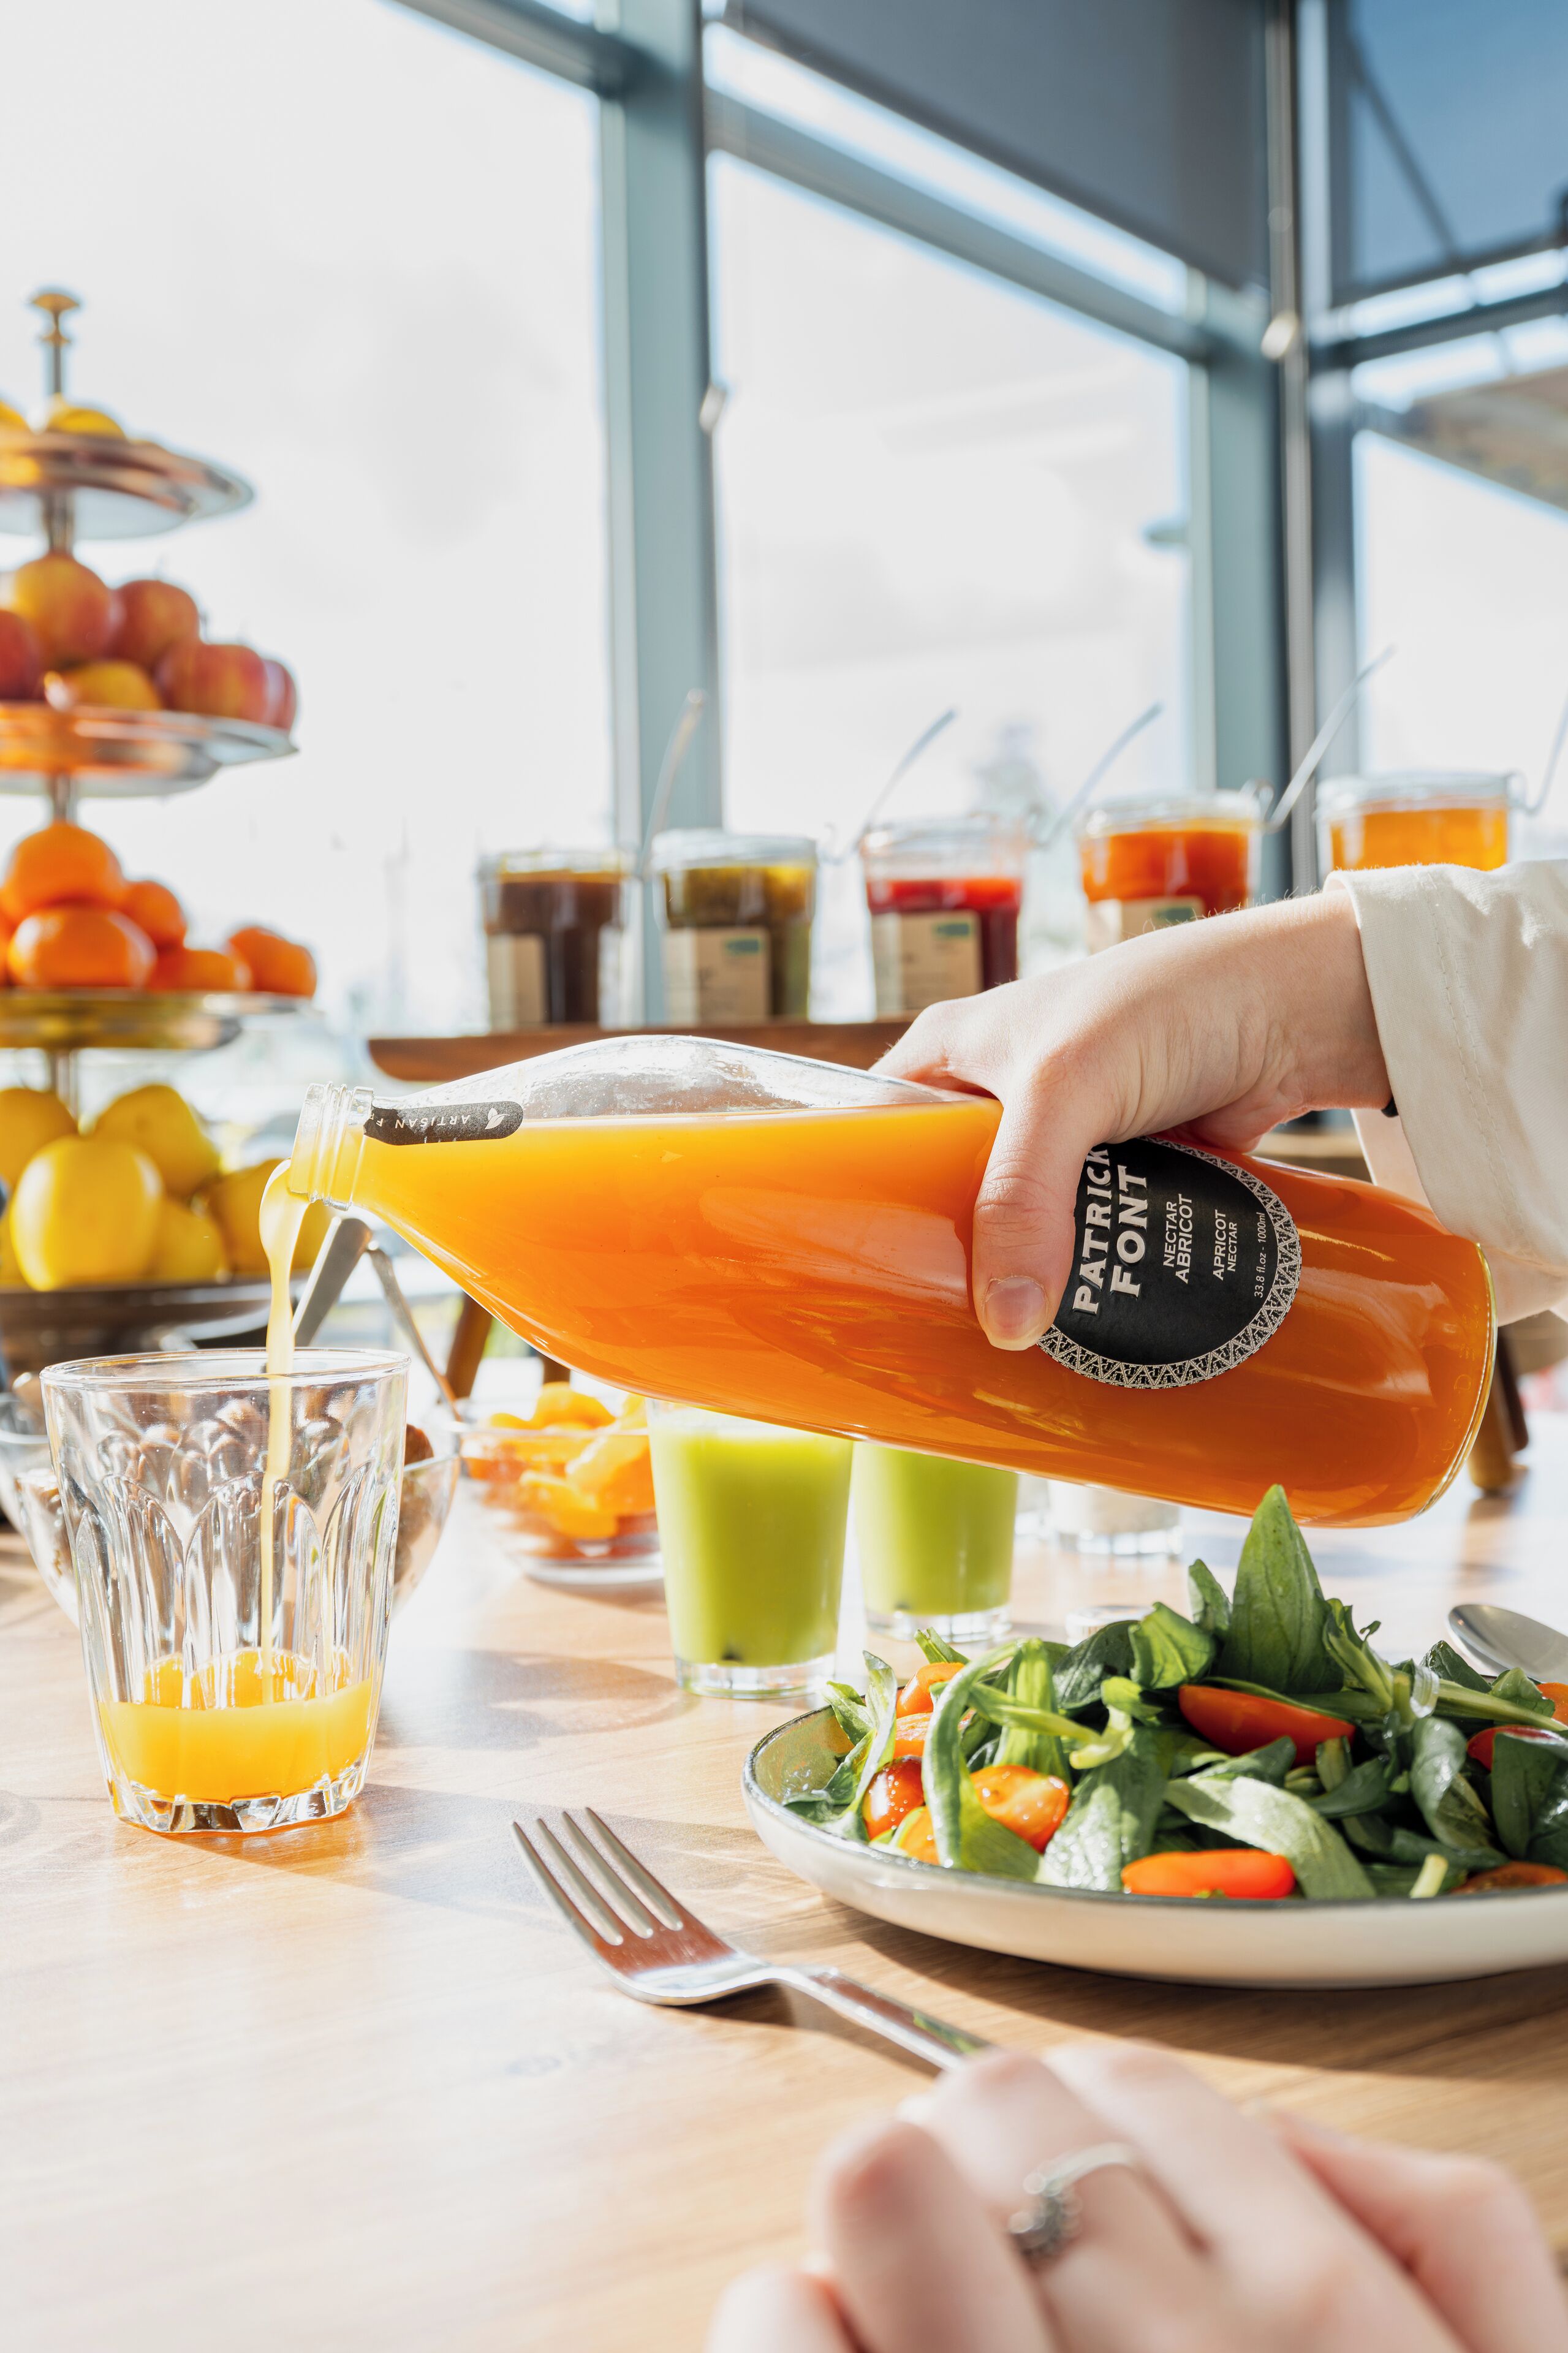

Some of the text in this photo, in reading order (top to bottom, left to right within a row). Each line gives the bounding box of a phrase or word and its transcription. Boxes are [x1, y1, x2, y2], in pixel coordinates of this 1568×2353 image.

[395, 1114, 471, 1129] ARTISAN
[1072, 1148, 1112, 1314] PATRICK
[1110, 1165, 1148, 1297] FONT
[1163, 1201, 1177, 1267] NECTAR
[1175, 1194, 1192, 1284] ABRICOT
[1213, 1209, 1227, 1281] APRICOT
[1227, 1222, 1237, 1272] NECTAR
[1256, 1211, 1267, 1243] 1000ml
[1254, 1276, 1265, 1298] 33.8
[1256, 1252, 1267, 1273] fl.oz
